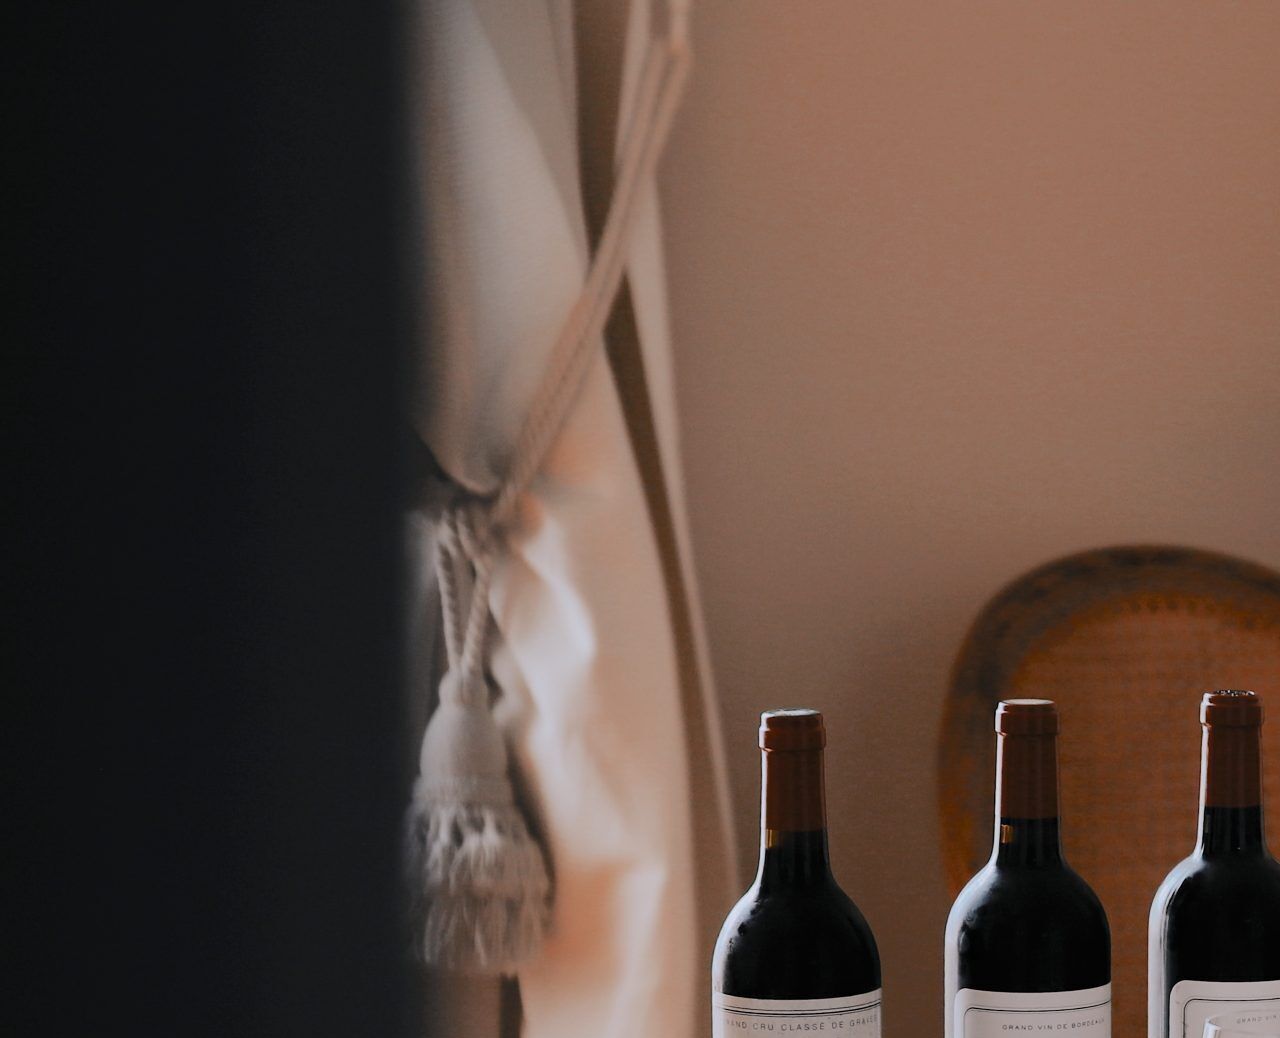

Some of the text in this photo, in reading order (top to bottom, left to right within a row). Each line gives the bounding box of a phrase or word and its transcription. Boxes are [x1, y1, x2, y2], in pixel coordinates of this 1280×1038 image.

[752, 1022, 774, 1031] CRU
[831, 1020, 844, 1029] DE
[1056, 1022, 1068, 1030] DE
